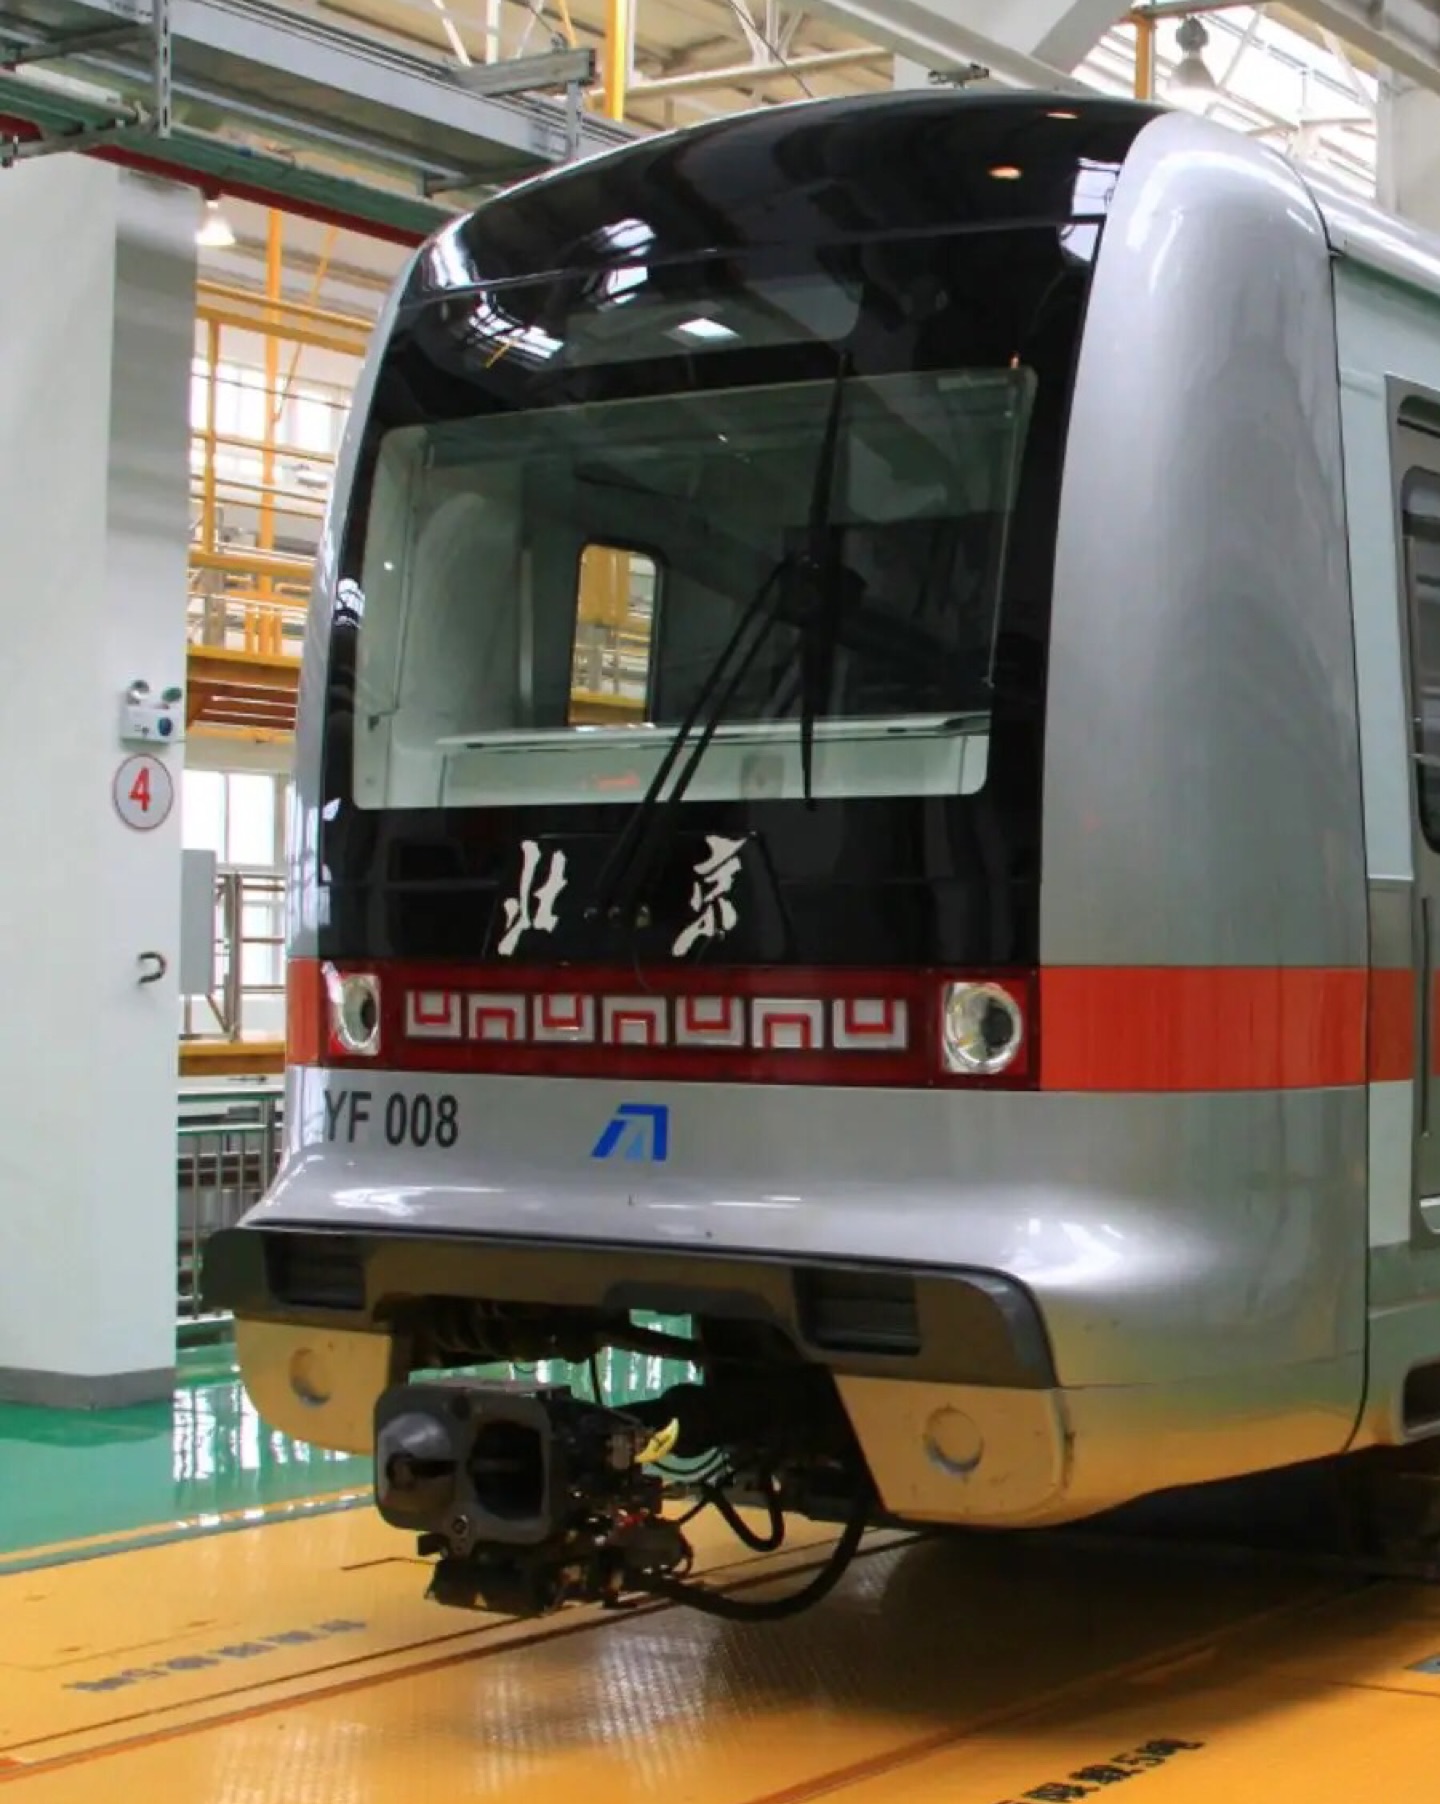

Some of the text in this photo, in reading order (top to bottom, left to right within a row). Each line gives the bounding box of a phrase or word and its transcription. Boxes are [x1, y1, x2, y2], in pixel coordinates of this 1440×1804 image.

[129, 767, 151, 811] 4
[498, 835, 746, 956] 北京
[325, 1090, 459, 1149] YF 008
